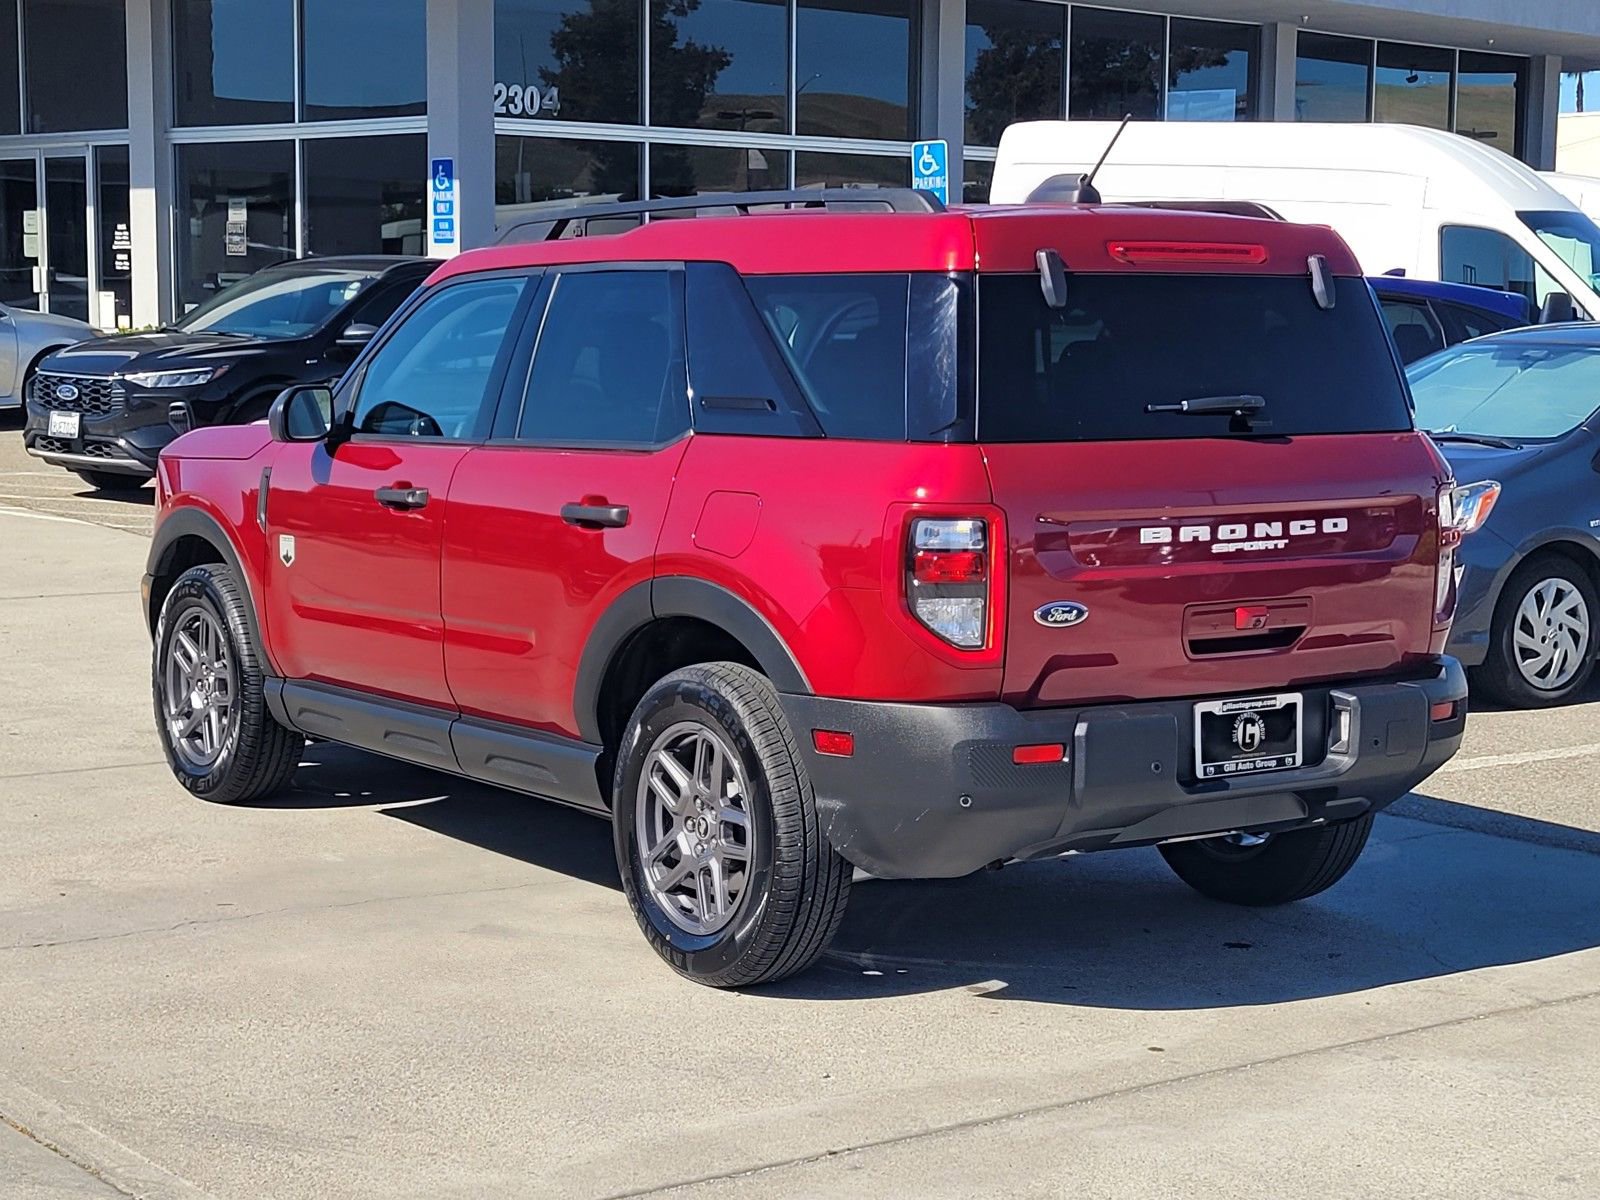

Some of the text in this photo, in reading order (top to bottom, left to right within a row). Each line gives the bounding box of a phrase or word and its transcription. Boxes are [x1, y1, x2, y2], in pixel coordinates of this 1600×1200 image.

[494, 83, 560, 116] 2304
[914, 176, 946, 189] PARKING
[432, 191, 454, 201] PARKING
[1140, 517, 1348, 544] BRONCO
[1211, 539, 1289, 553] SPORT
[1047, 606, 1078, 621] Ford
[1258, 719, 1266, 740] GROUP
[1223, 760, 1277, 772] Gill Auto Group
